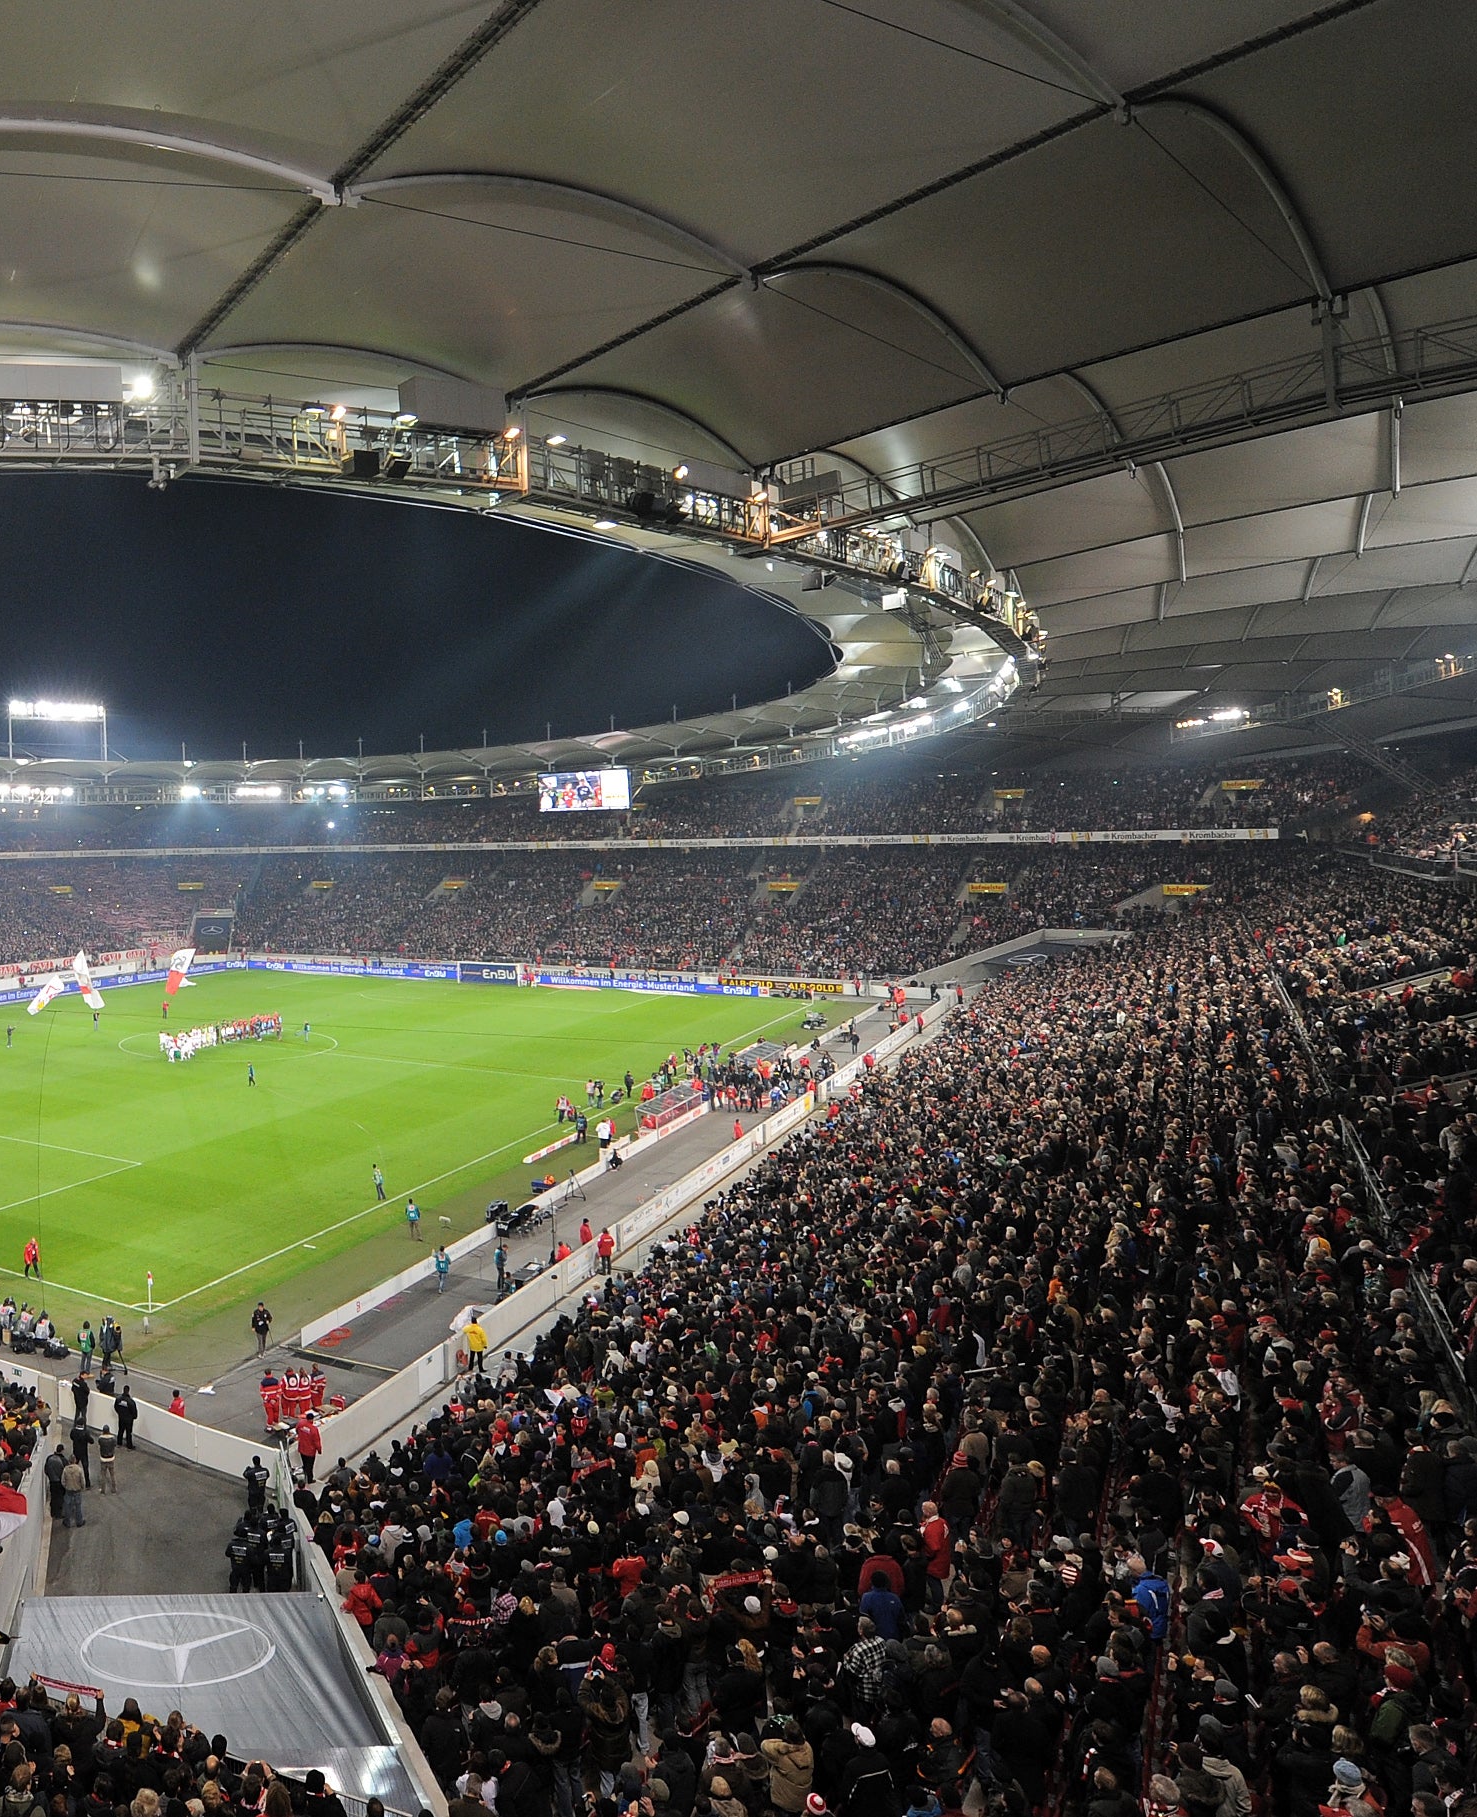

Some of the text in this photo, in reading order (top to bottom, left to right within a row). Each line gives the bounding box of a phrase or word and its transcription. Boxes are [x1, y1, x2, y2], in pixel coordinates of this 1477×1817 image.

[1189, 831, 1236, 839] Krombacher
[292, 963, 330, 971] Willkommen
[340, 965, 406, 976] Energie-Musterland.
[425, 970, 447, 978] EnBW
[483, 969, 516, 980] EnBW
[118, 976, 134, 984] EnBW
[551, 976, 599, 986] Willkommen
[601, 978, 612, 987] im
[613, 979, 698, 992] Energie-Musterland.
[723, 986, 752, 995] EnBW
[8, 993, 16, 1001] im
